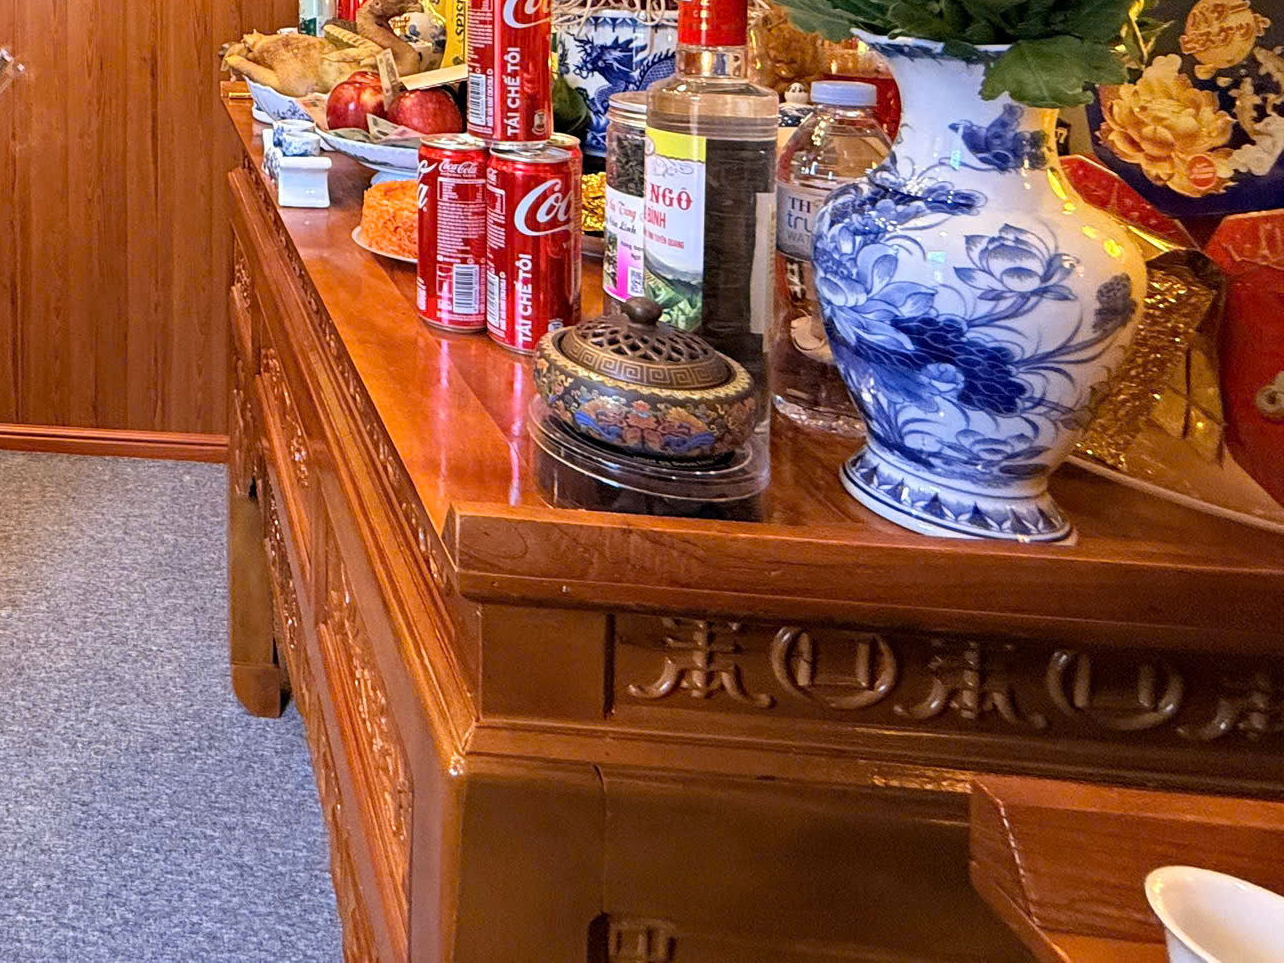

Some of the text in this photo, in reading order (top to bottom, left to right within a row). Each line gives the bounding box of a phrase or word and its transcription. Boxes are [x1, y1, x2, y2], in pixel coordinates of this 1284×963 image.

[502, 47, 521, 137] TÁI CHẾ TÔI
[649, 183, 693, 211] NGÔ
[788, 196, 811, 213] TH
[514, 253, 533, 350] TÁI CHẾ TÔI
